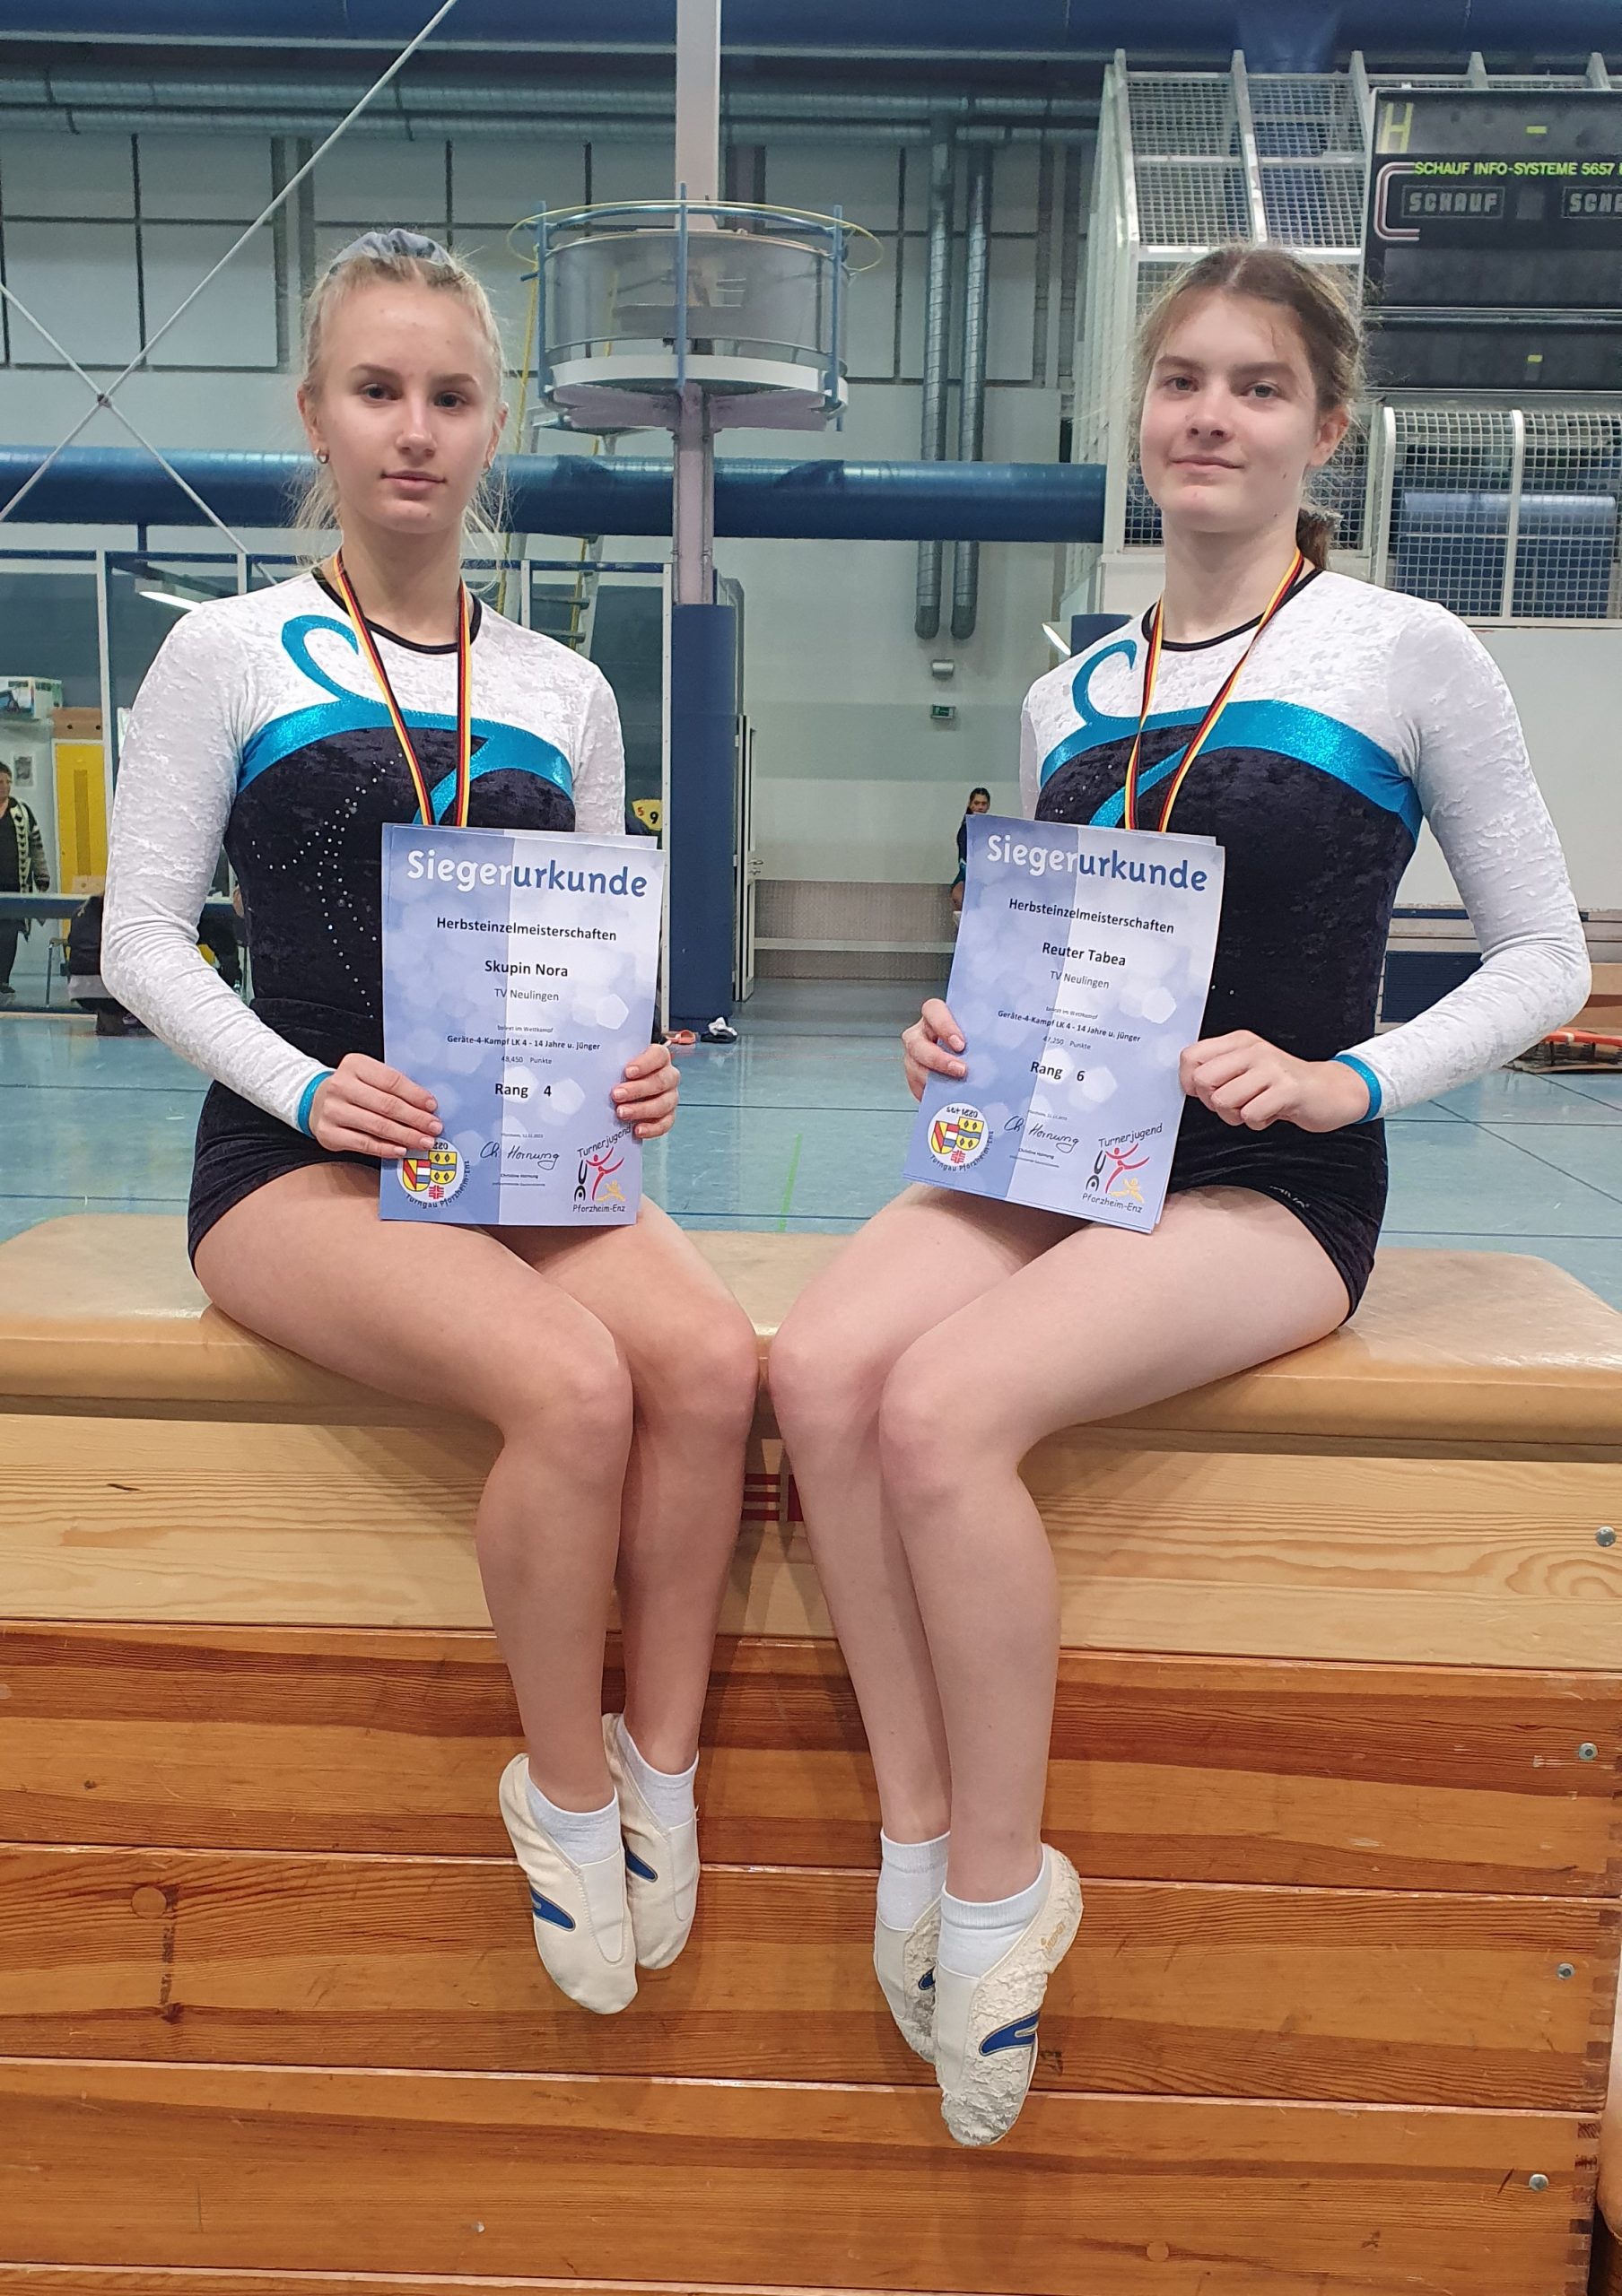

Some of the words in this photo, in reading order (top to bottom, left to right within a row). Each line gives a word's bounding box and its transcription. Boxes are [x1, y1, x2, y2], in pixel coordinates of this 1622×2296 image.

[1414, 162, 1470, 176] SCHAUF
[1473, 162, 1578, 176] INFO-SYSTEME
[1581, 162, 1616, 176] 5657
[1408, 193, 1498, 213] SCHAUF
[987, 834, 1208, 891] Siegerurkunde
[406, 848, 649, 898] Siegerurkunde
[1008, 898, 1175, 934] Herbsteinzelmeisterschaften
[436, 916, 617, 941] Herbsteinzelmeisterschaften
[1042, 942, 1085, 960] Reuter
[1088, 949, 1127, 967] Tabea
[484, 960, 532, 976] Skupin
[536, 963, 569, 978] Nora
[1050, 970, 1063, 981] TV
[1063, 972, 1111, 990] Neulingen
[494, 988, 508, 998] TV
[510, 989, 560, 1003] Neulingen
[998, 1010, 1055, 1027] Geräte-4-Kampf
[1056, 1021, 1066, 1029] LK
[1077, 1024, 1086, 1032] 14
[1086, 1026, 1107, 1037] Jahre
[1116, 1031, 1141, 1043] jünger
[447, 1035, 510, 1047] Geräte-4-Kampf
[511, 1039, 520, 1047] LK
[522, 1039, 528, 1047] 4
[534, 1039, 544, 1048] 14
[545, 1040, 565, 1049] Jahre
[576, 1041, 601, 1051] jünger
[529, 1057, 553, 1065] Punkte
[1030, 1061, 1063, 1080] Rang
[1076, 1070, 1086, 1082] 6
[494, 1083, 529, 1099] Rang
[544, 1085, 553, 1097] 4
[577, 1122, 632, 1158] Turnerjugend
[1098, 1123, 1164, 1149] Turnerjugend
[406, 1194, 439, 1209] Turngau
[572, 1204, 625, 1213] Pforzheim-Enz
[1082, 1193, 1143, 1213] Pforzheim-Enz
